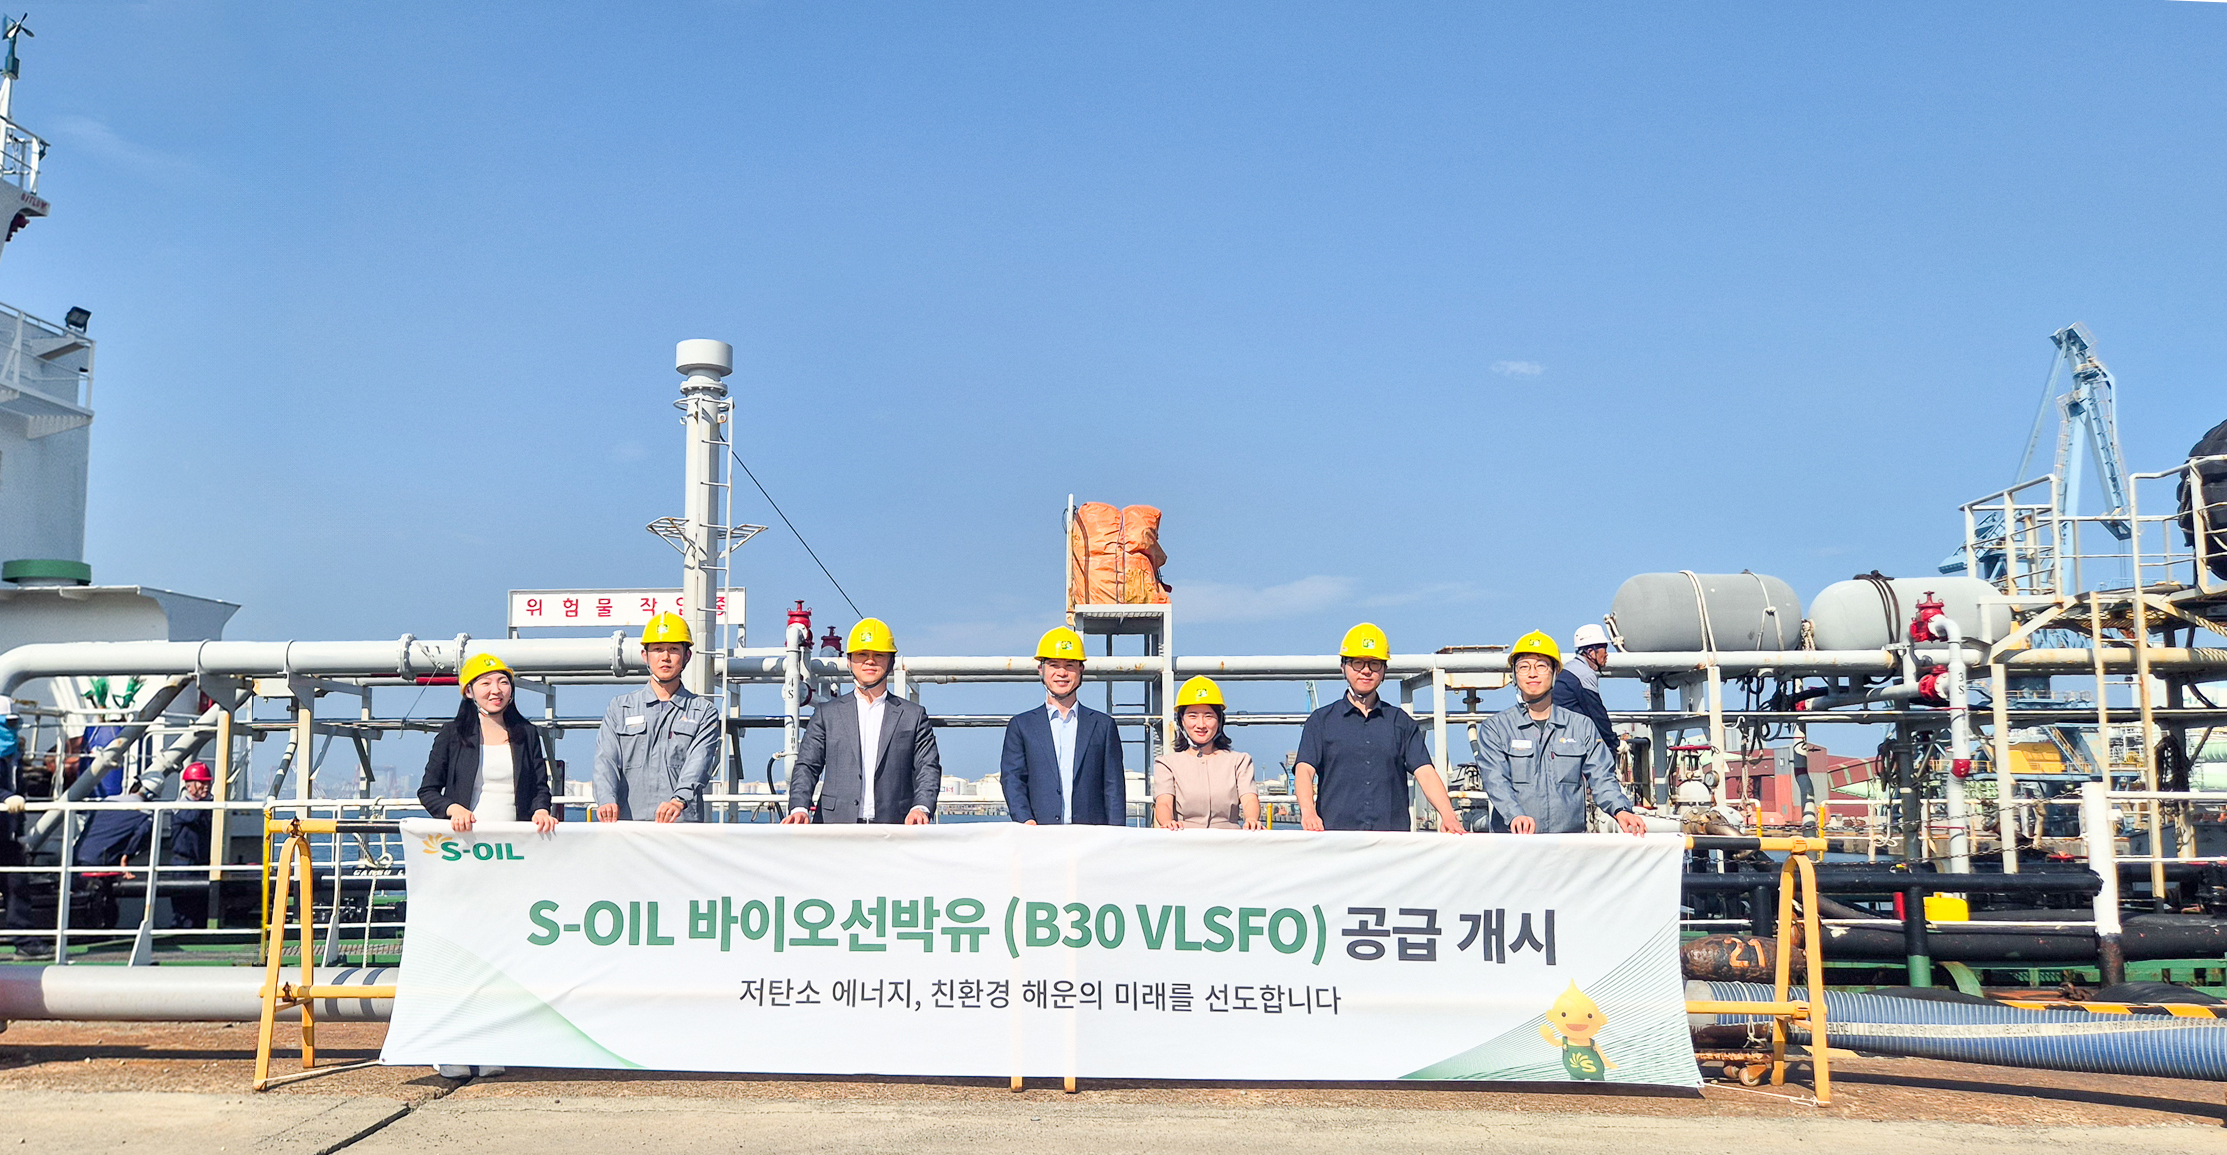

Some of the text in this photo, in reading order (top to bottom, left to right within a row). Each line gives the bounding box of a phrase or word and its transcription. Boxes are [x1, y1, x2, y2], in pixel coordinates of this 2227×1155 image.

[526, 597, 613, 618] 위험물
[440, 841, 525, 862] S-OIL
[526, 895, 1557, 966] S-OIL 바이오선박유 (B30 VLSFO) 공급 개시
[739, 977, 1342, 1015] 저탄소 에너지, 친환경 해운의 미래를 선도합니다
